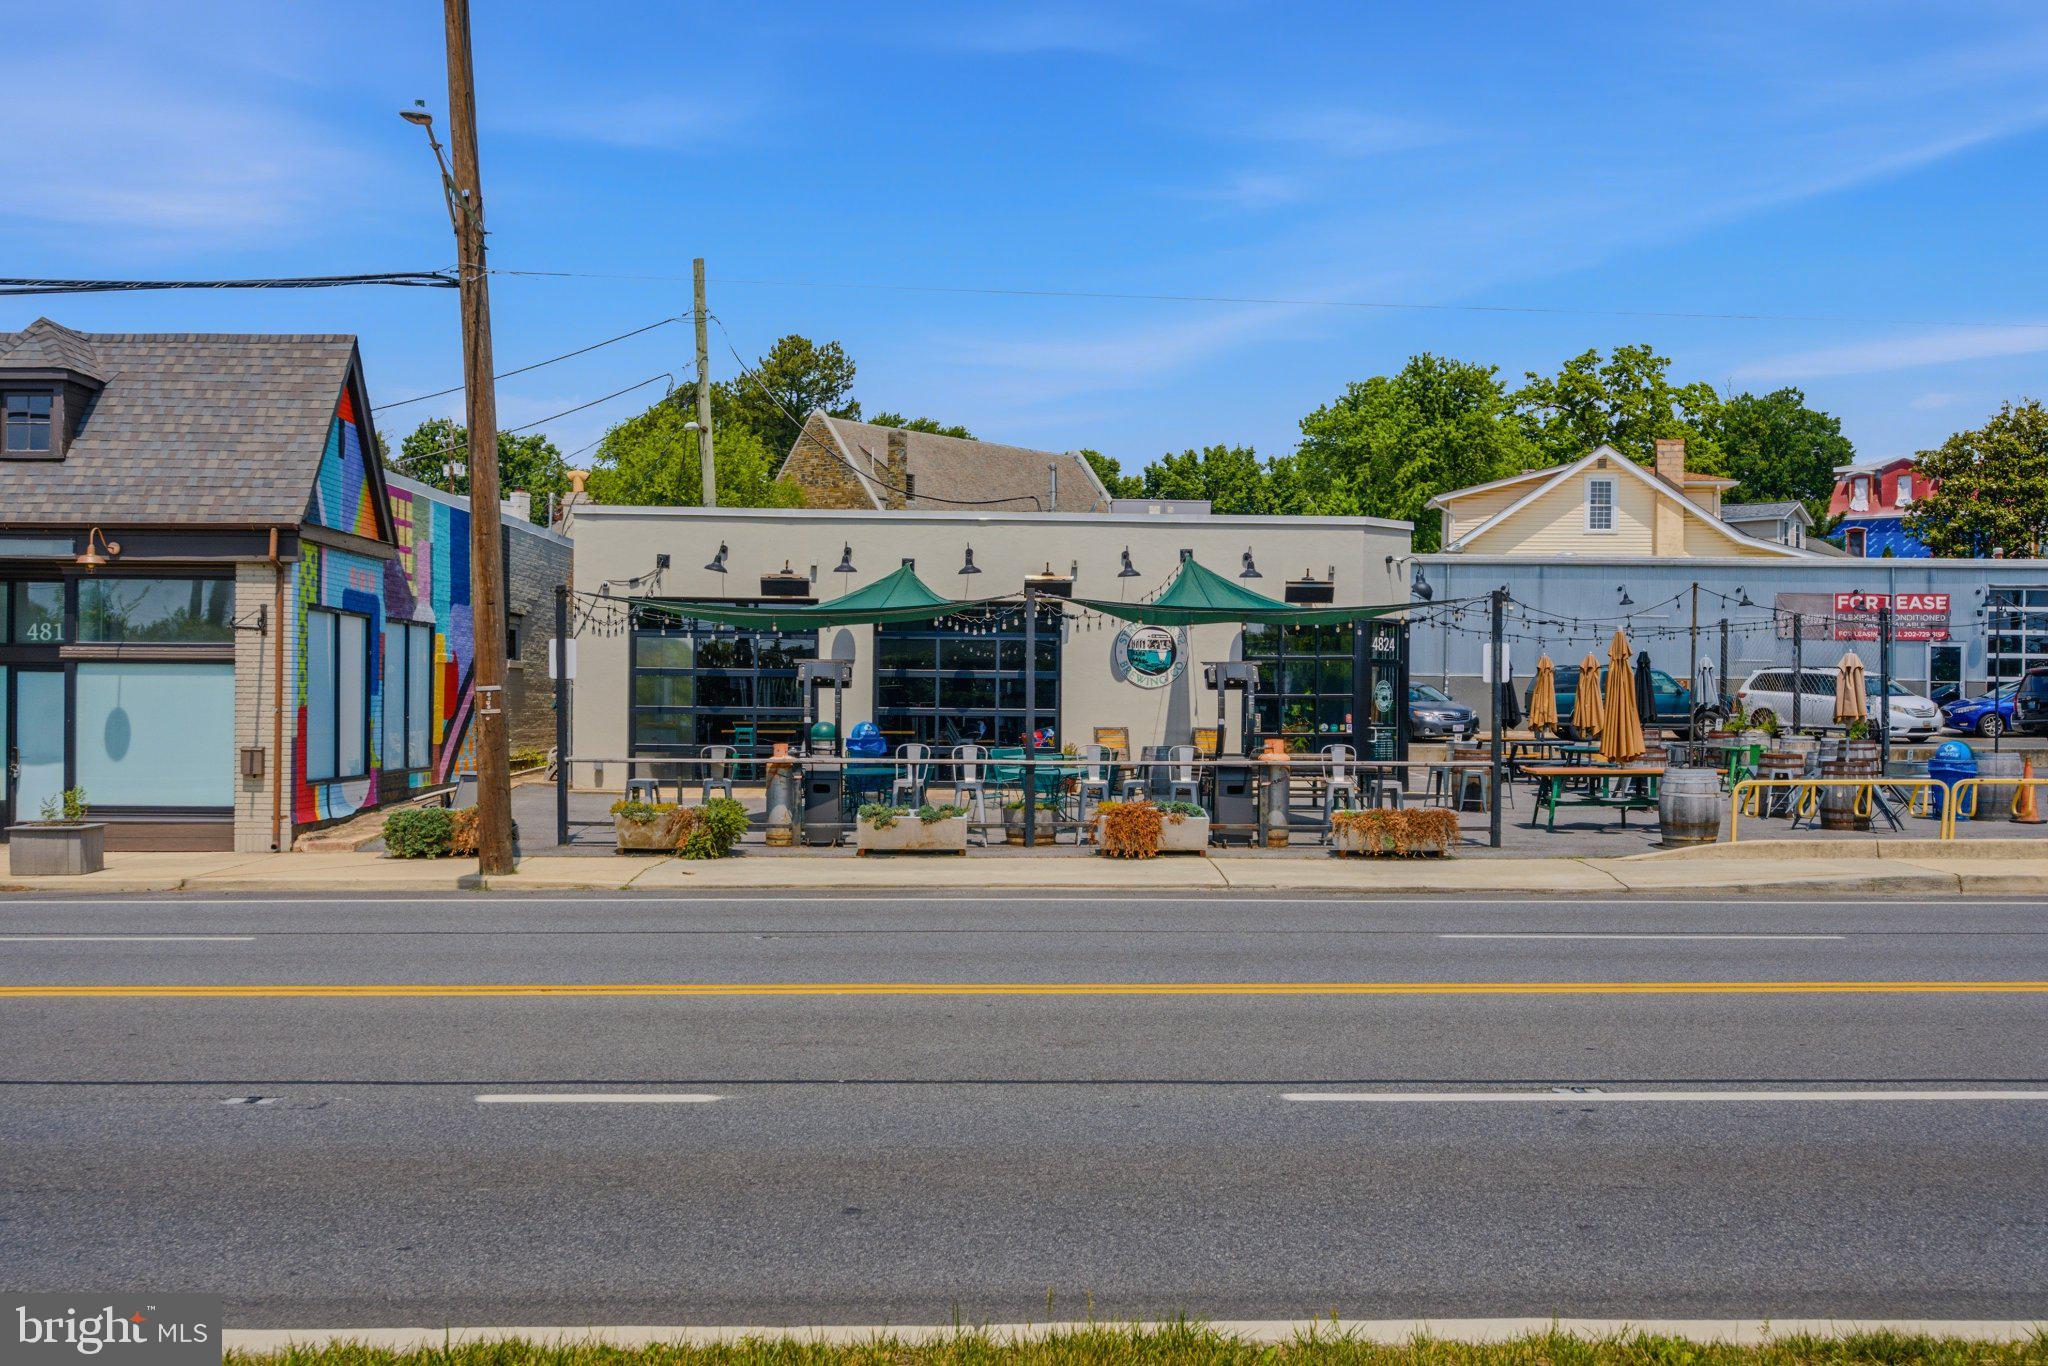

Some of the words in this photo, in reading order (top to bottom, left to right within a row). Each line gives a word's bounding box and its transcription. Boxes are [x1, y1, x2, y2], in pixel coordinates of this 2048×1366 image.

[1837, 595, 1879, 610] FOR
[1371, 637, 1396, 652] 4824
[1119, 661, 1168, 685] BREWING
